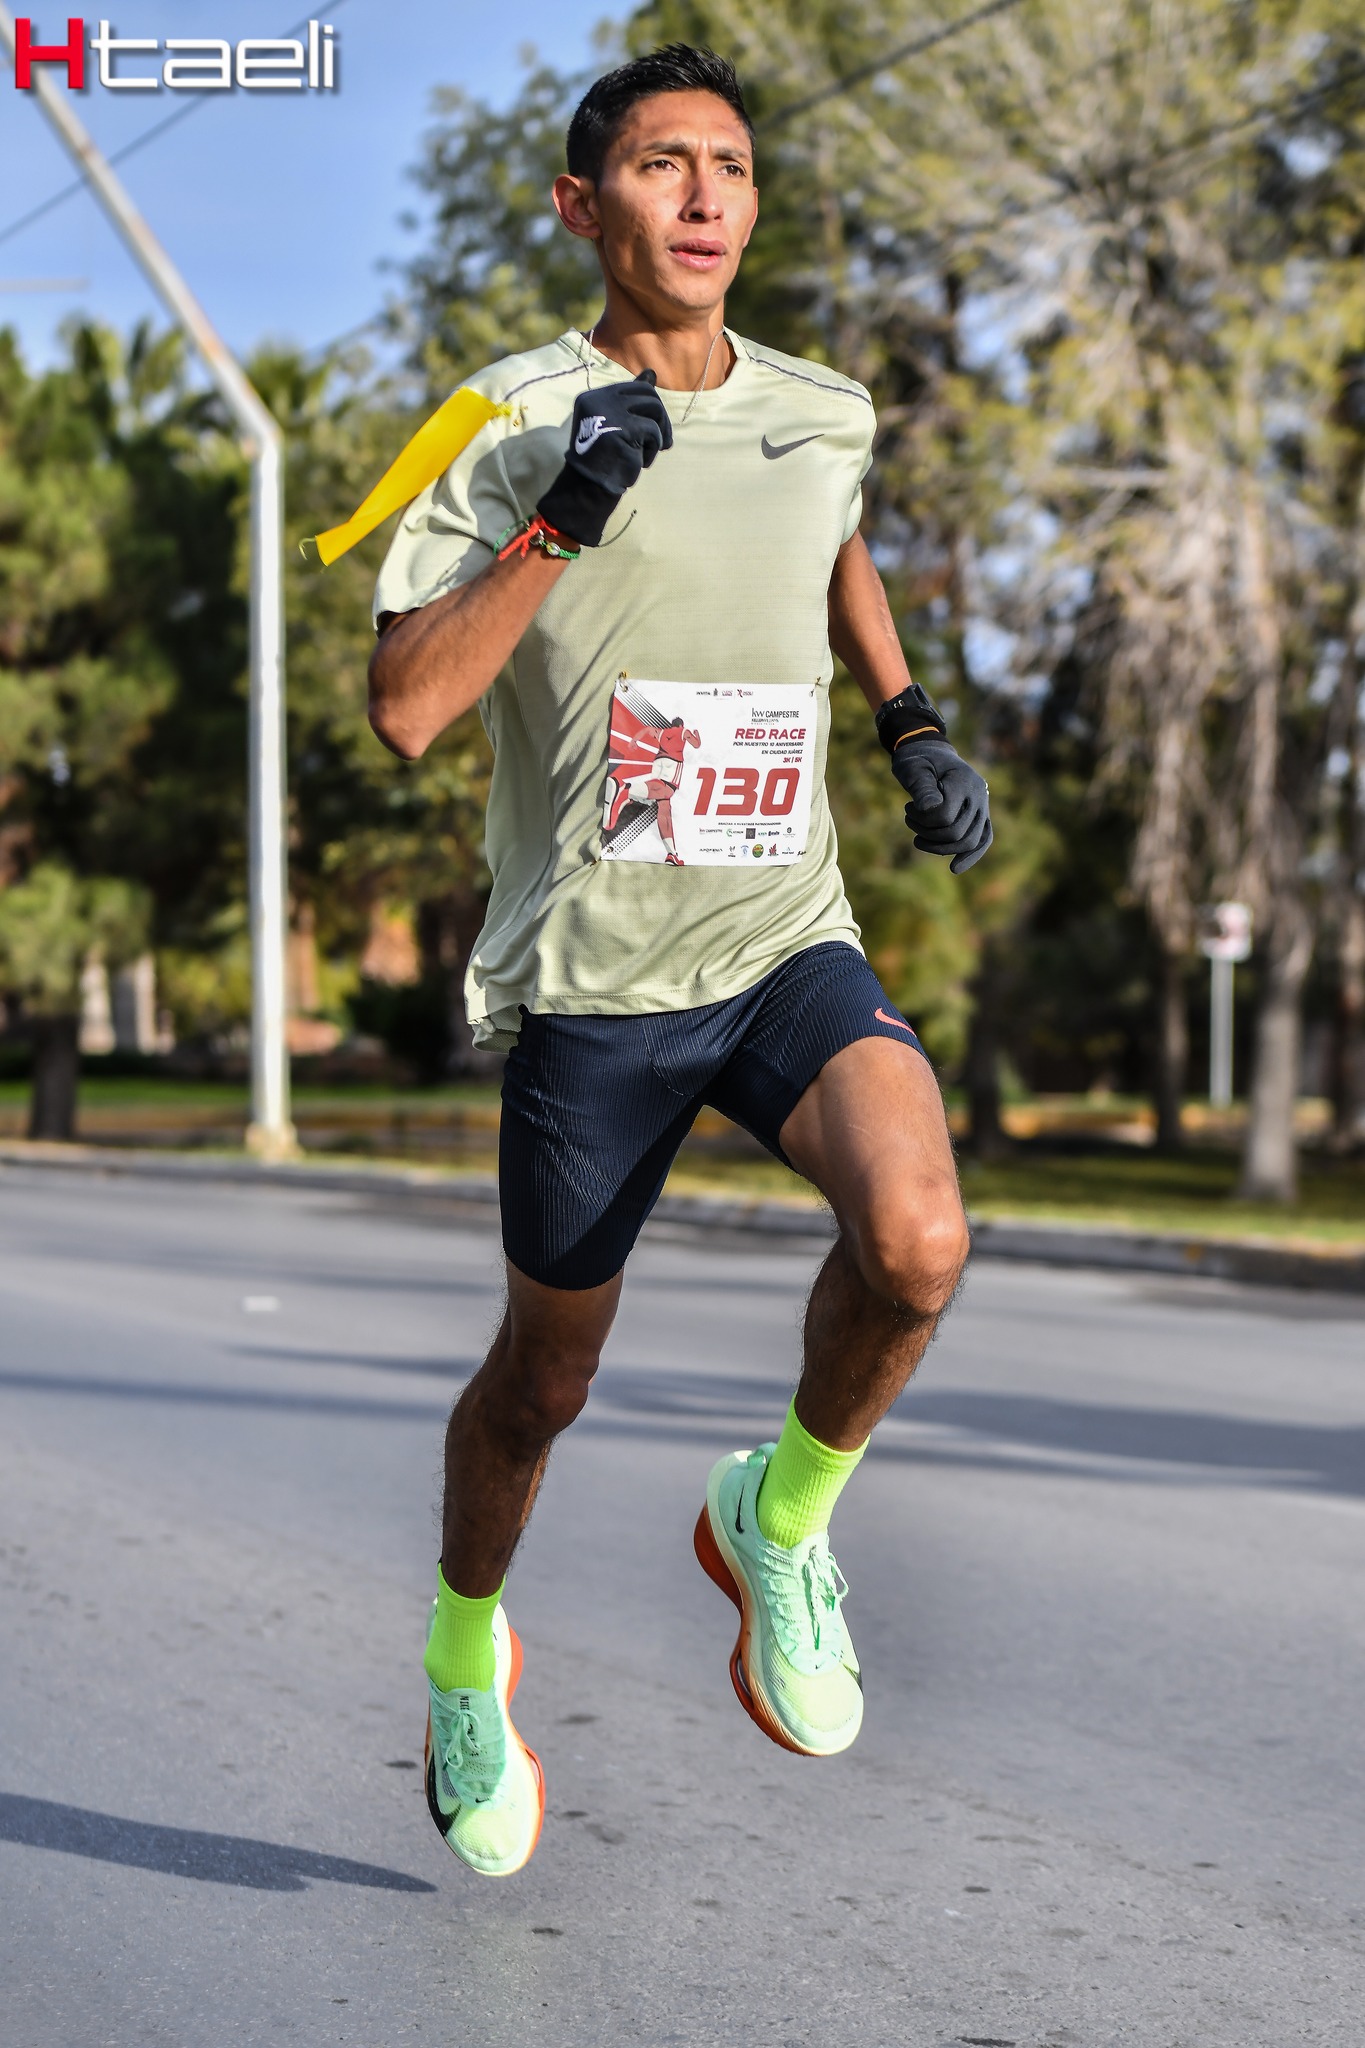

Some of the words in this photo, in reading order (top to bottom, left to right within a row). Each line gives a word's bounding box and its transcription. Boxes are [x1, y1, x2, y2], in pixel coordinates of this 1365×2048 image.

[579, 415, 607, 440] NIKE
[765, 710, 800, 719] CAMPESTRE
[735, 728, 766, 740] RED
[768, 728, 807, 740] RACE
[693, 767, 801, 816] 130
